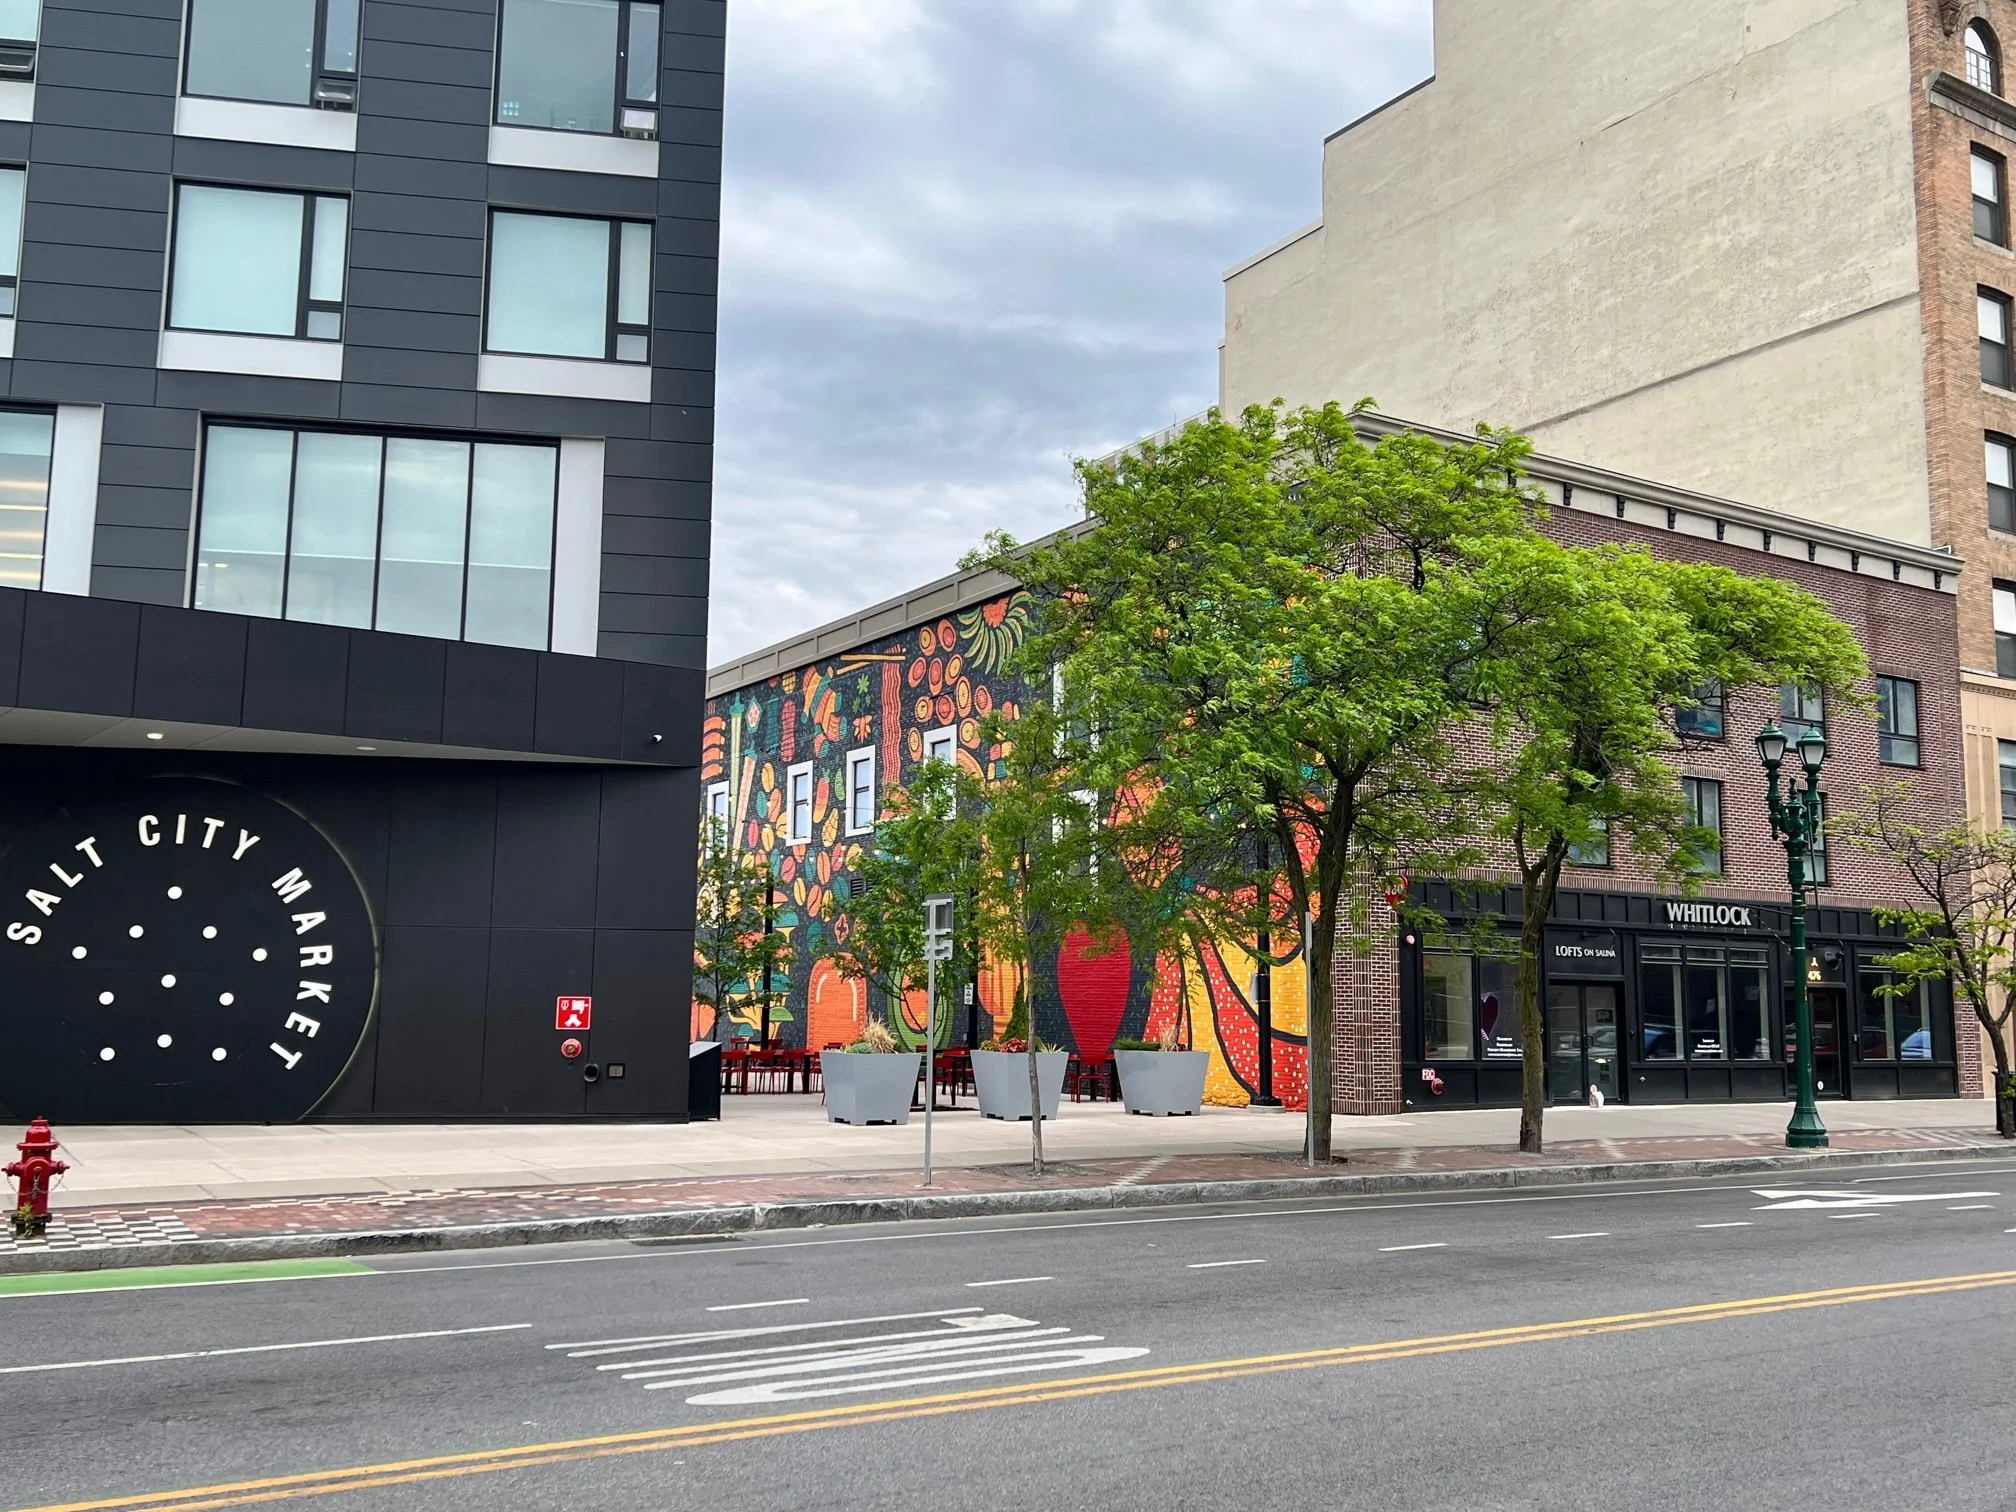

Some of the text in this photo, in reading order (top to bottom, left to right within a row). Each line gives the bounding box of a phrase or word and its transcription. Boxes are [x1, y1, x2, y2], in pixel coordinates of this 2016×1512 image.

[1666, 902, 1752, 926] WHITLOCK
[6, 814, 333, 1070] SALT CITY MARKET
[1555, 945, 1616, 958] LOFTS ON SALINA
